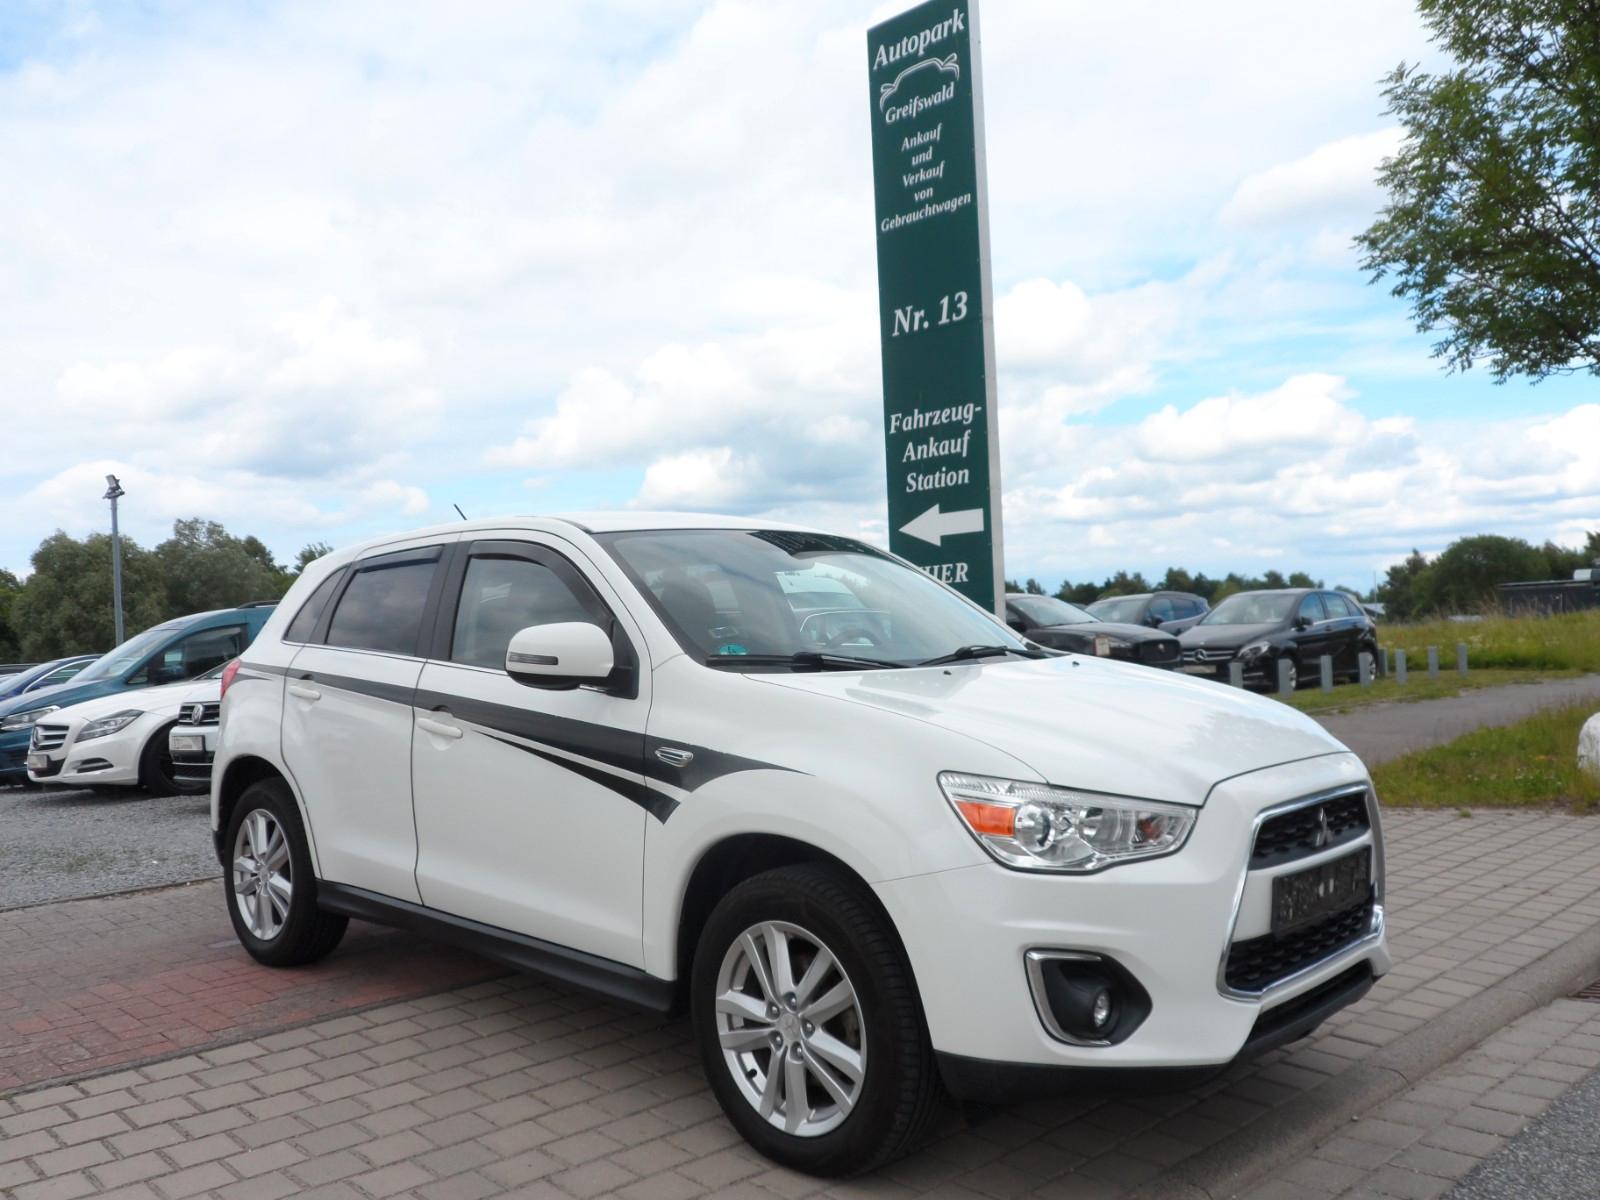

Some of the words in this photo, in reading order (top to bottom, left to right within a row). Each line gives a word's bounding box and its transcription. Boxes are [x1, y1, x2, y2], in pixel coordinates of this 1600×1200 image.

[873, 8, 964, 70] Autopark
[885, 82, 954, 124] Greifswald
[901, 123, 942, 151] Ankauf
[911, 147, 933, 166] und
[902, 161, 944, 187] Verkauf
[914, 187, 933, 202] von
[880, 193, 971, 232] Gebrauchtwagen
[892, 306, 929, 337] Nr.
[938, 291, 968, 325] 13
[889, 402, 982, 434] Fahrzeug-
[902, 430, 971, 463] Ankauf
[905, 468, 970, 493] Station
